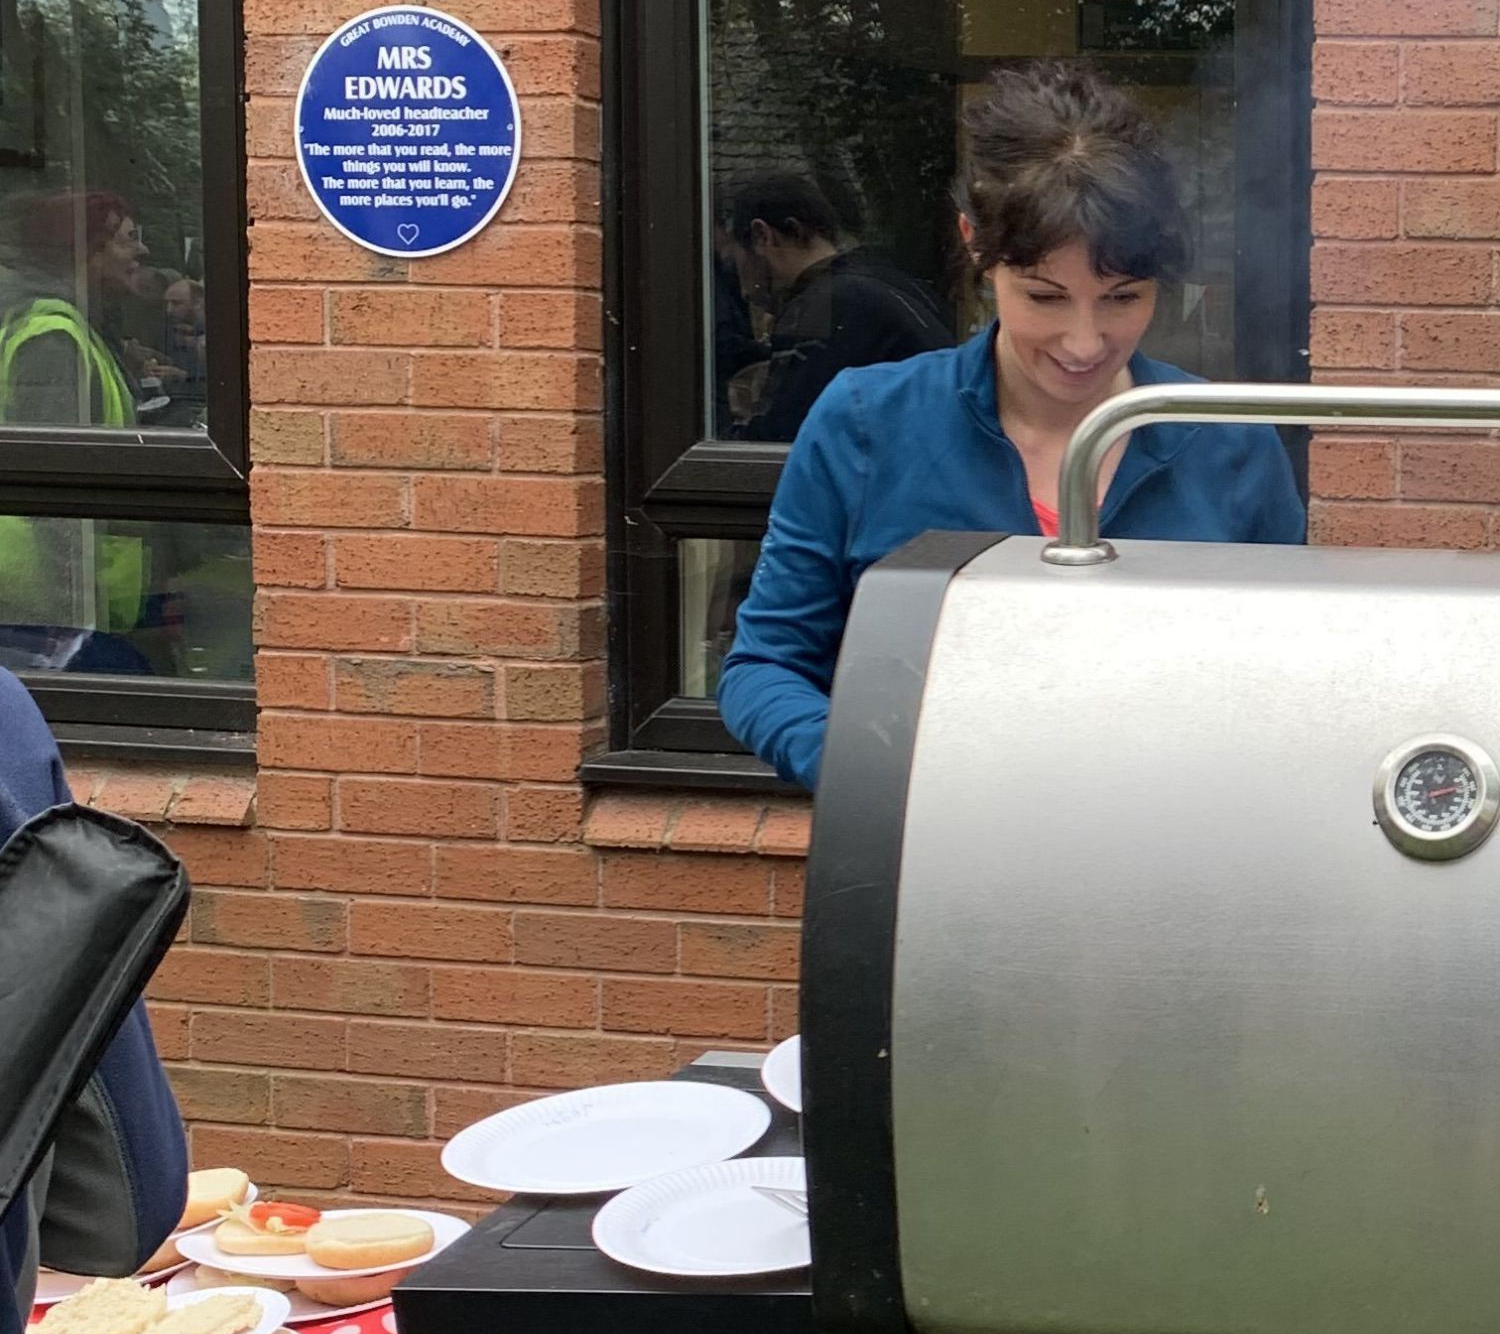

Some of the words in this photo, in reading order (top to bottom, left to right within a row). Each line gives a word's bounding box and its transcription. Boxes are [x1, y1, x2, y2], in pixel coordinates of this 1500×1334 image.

[340, 24, 371, 47] GREAT
[373, 15, 419, 30] BOWDEN
[422, 16, 472, 47] ACADEMY
[377, 46, 431, 69] MRS
[345, 76, 467, 99] EDWARDS
[324, 107, 400, 120] Much-loved
[404, 108, 488, 120] headteacher
[372, 124, 439, 137] 2006-2017
[333, 145, 364, 156] more
[368, 144, 391, 156] that
[395, 146, 417, 157] you
[420, 144, 452, 157] read,
[455, 144, 476, 156] the
[479, 145, 511, 156] more
[343, 160, 380, 174] things
[383, 162, 405, 174] you
[409, 160, 430, 172] will
[434, 160, 471, 172] know.
[322, 176, 344, 189] The
[348, 179, 379, 189] more
[382, 177, 406, 189] that
[409, 179, 432, 190] you
[435, 176, 469, 190] learn,
[473, 177, 494, 189] the
[340, 195, 371, 205] more
[374, 193, 413, 207] places
[416, 193, 448, 207] you'll
